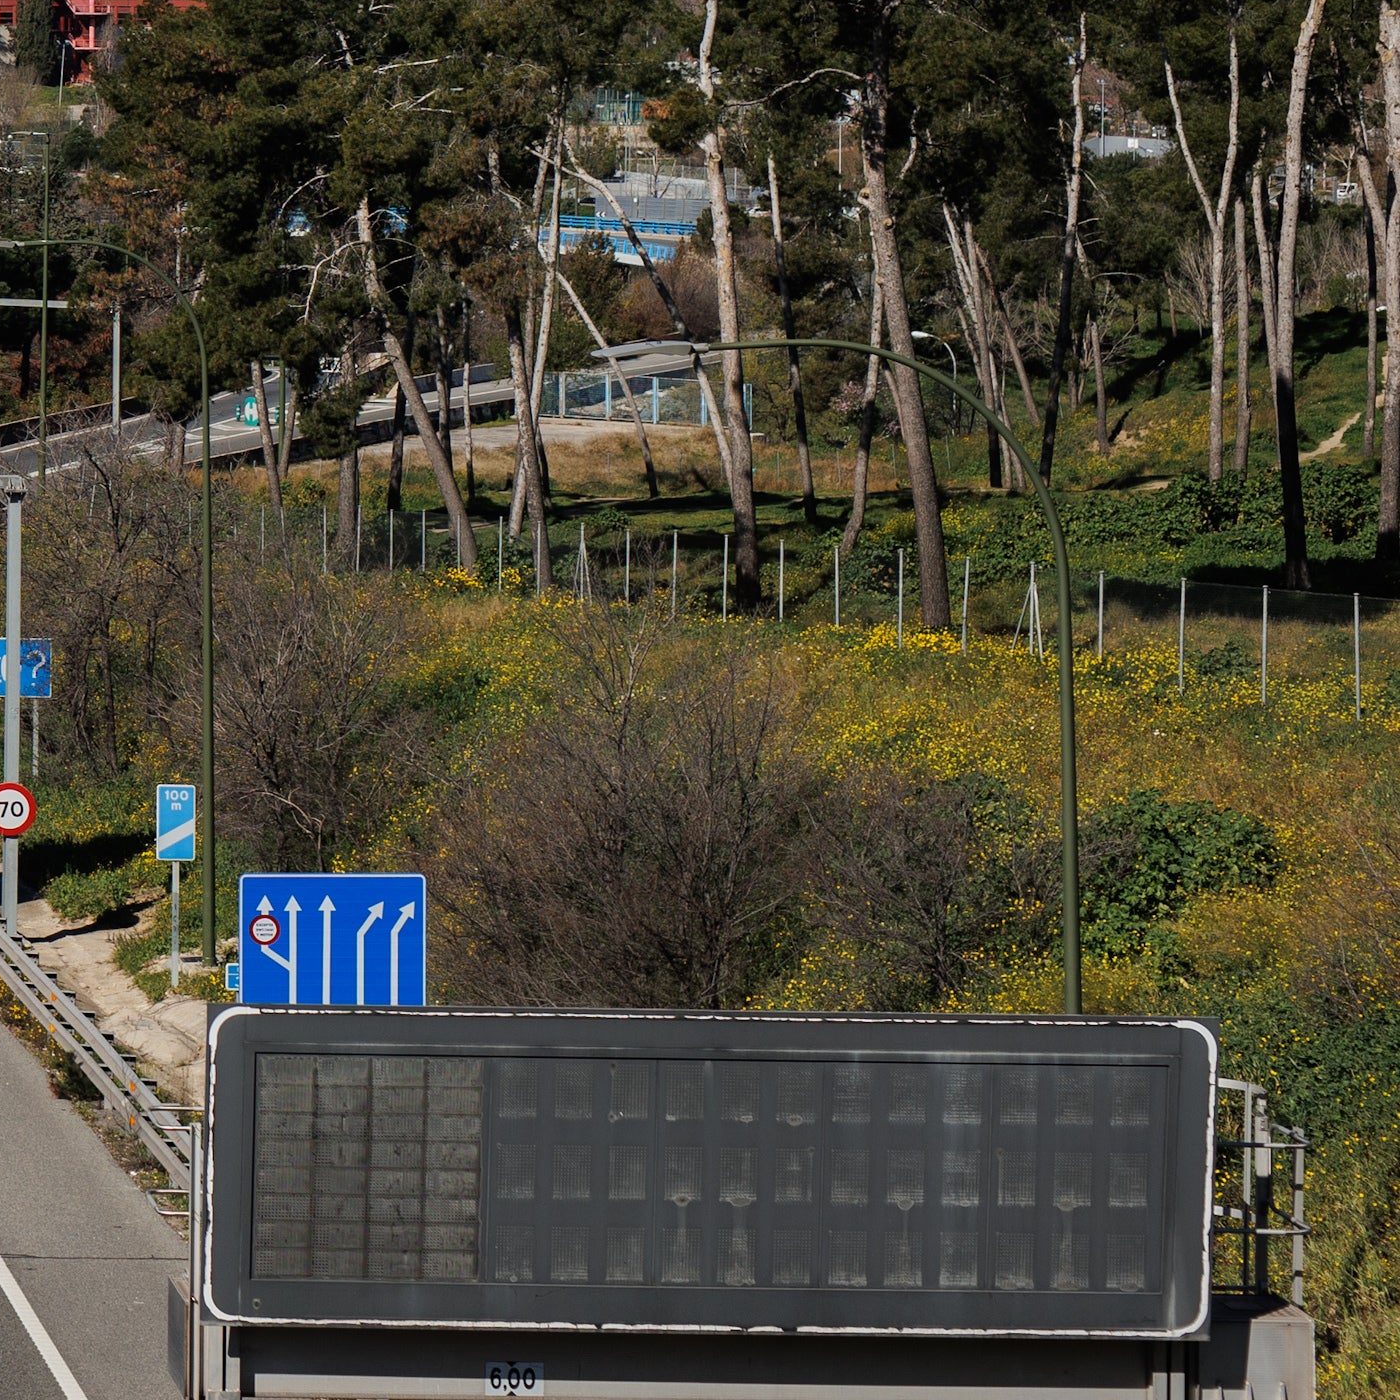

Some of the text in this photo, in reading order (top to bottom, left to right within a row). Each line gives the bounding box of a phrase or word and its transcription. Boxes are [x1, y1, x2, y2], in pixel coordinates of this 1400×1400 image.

[164, 790, 189, 801] 100
[171, 801, 182, 811] m
[490, 1367, 536, 1392] 6,00
